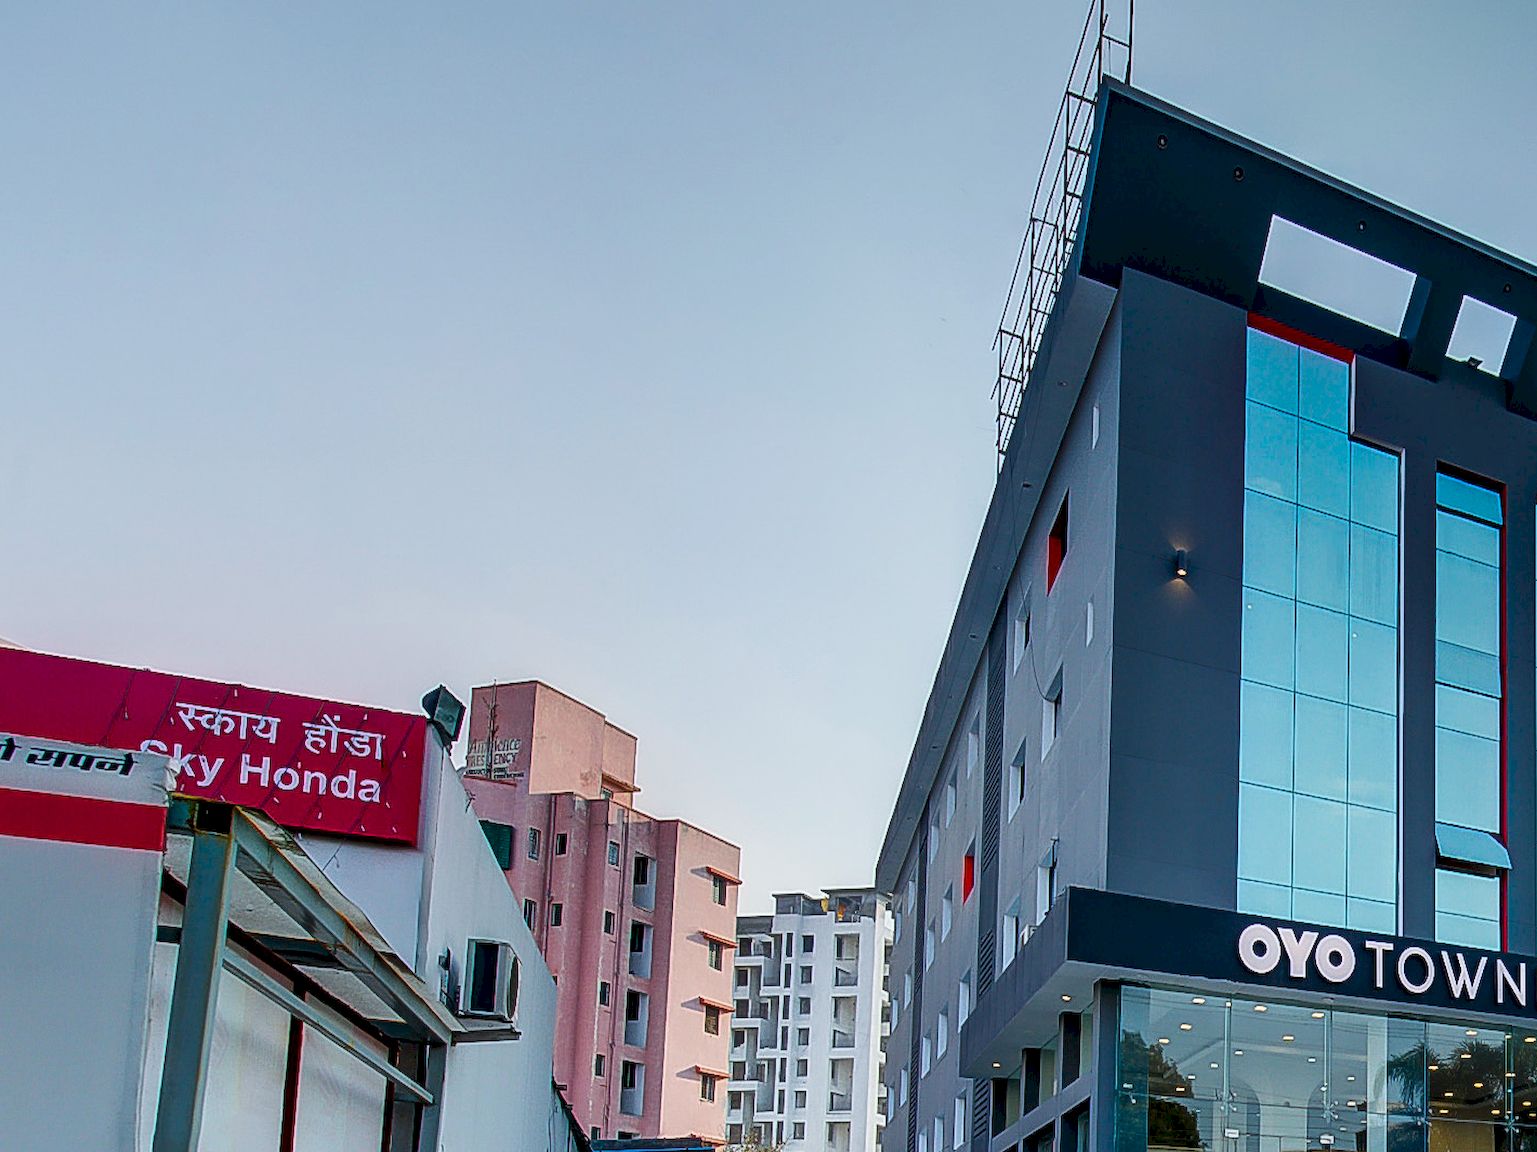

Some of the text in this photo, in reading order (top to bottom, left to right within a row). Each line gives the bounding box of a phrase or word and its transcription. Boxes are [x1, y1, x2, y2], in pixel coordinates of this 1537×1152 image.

[176, 702, 280, 744] स्काय
[240, 754, 381, 803] Honda
[1238, 923, 1356, 983] OYO
